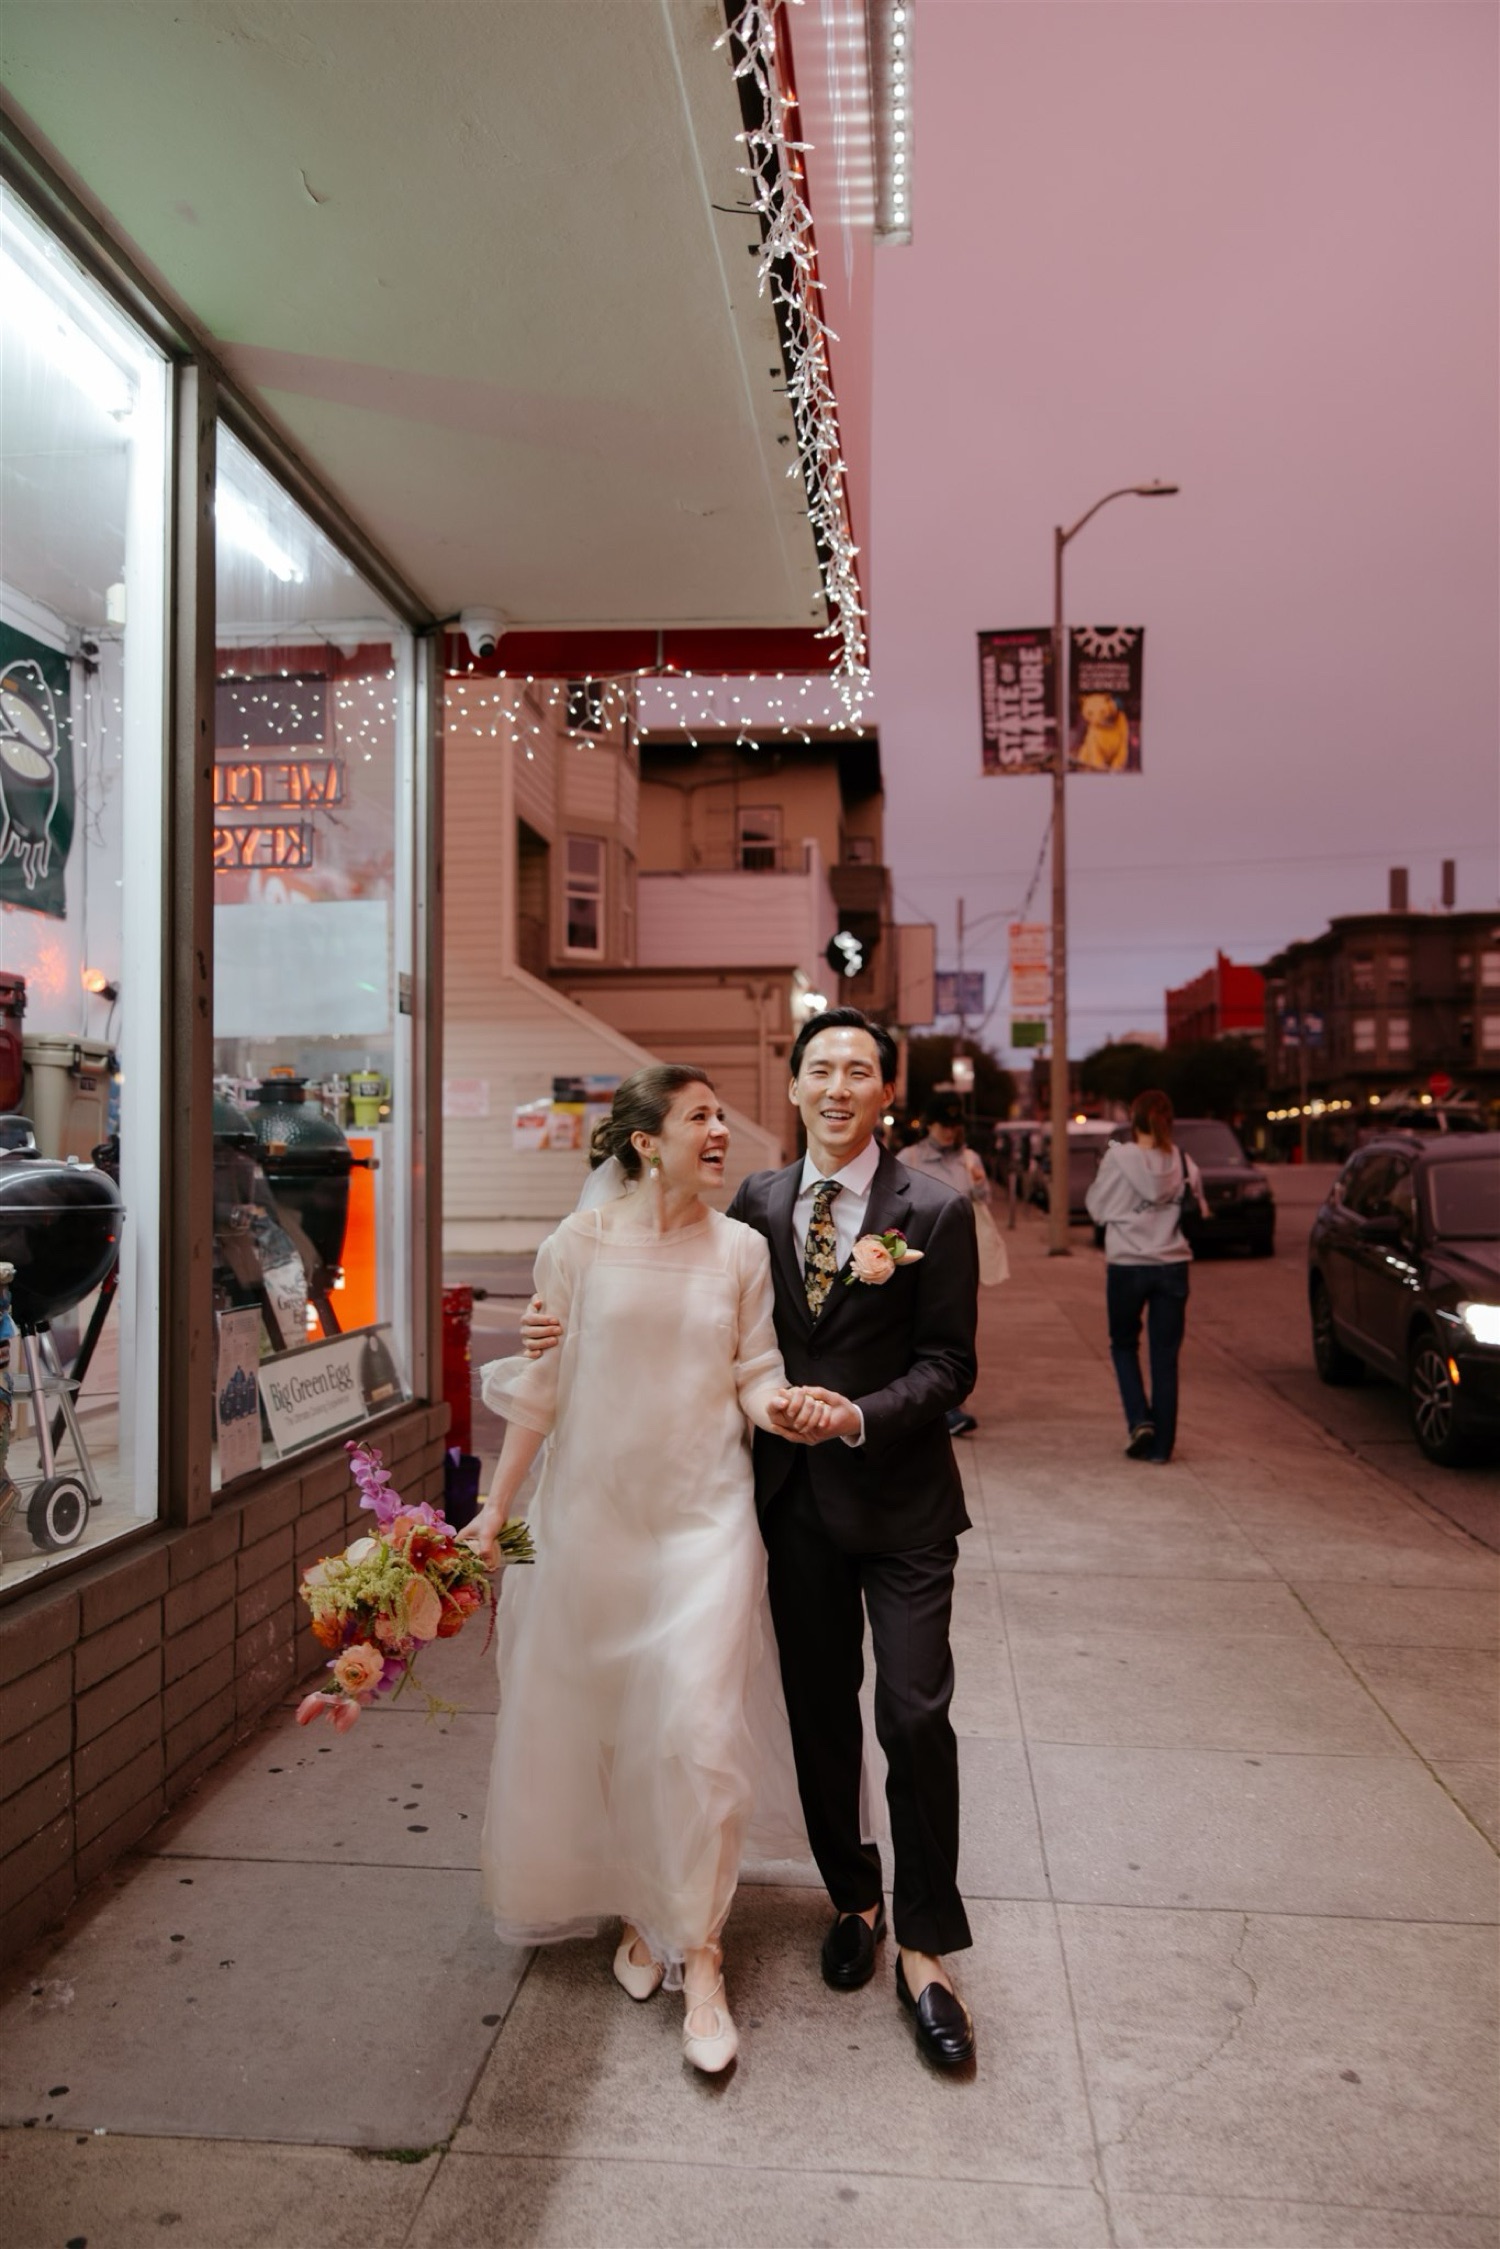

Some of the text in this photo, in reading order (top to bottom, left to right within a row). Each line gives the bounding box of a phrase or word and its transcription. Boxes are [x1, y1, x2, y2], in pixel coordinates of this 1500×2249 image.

[998, 684, 1023, 766] STATE
[1019, 646, 1049, 754] NATURE
[269, 1382, 294, 1413] Big
[290, 1373, 329, 1403] Green
[326, 1362, 354, 1392] Egg
